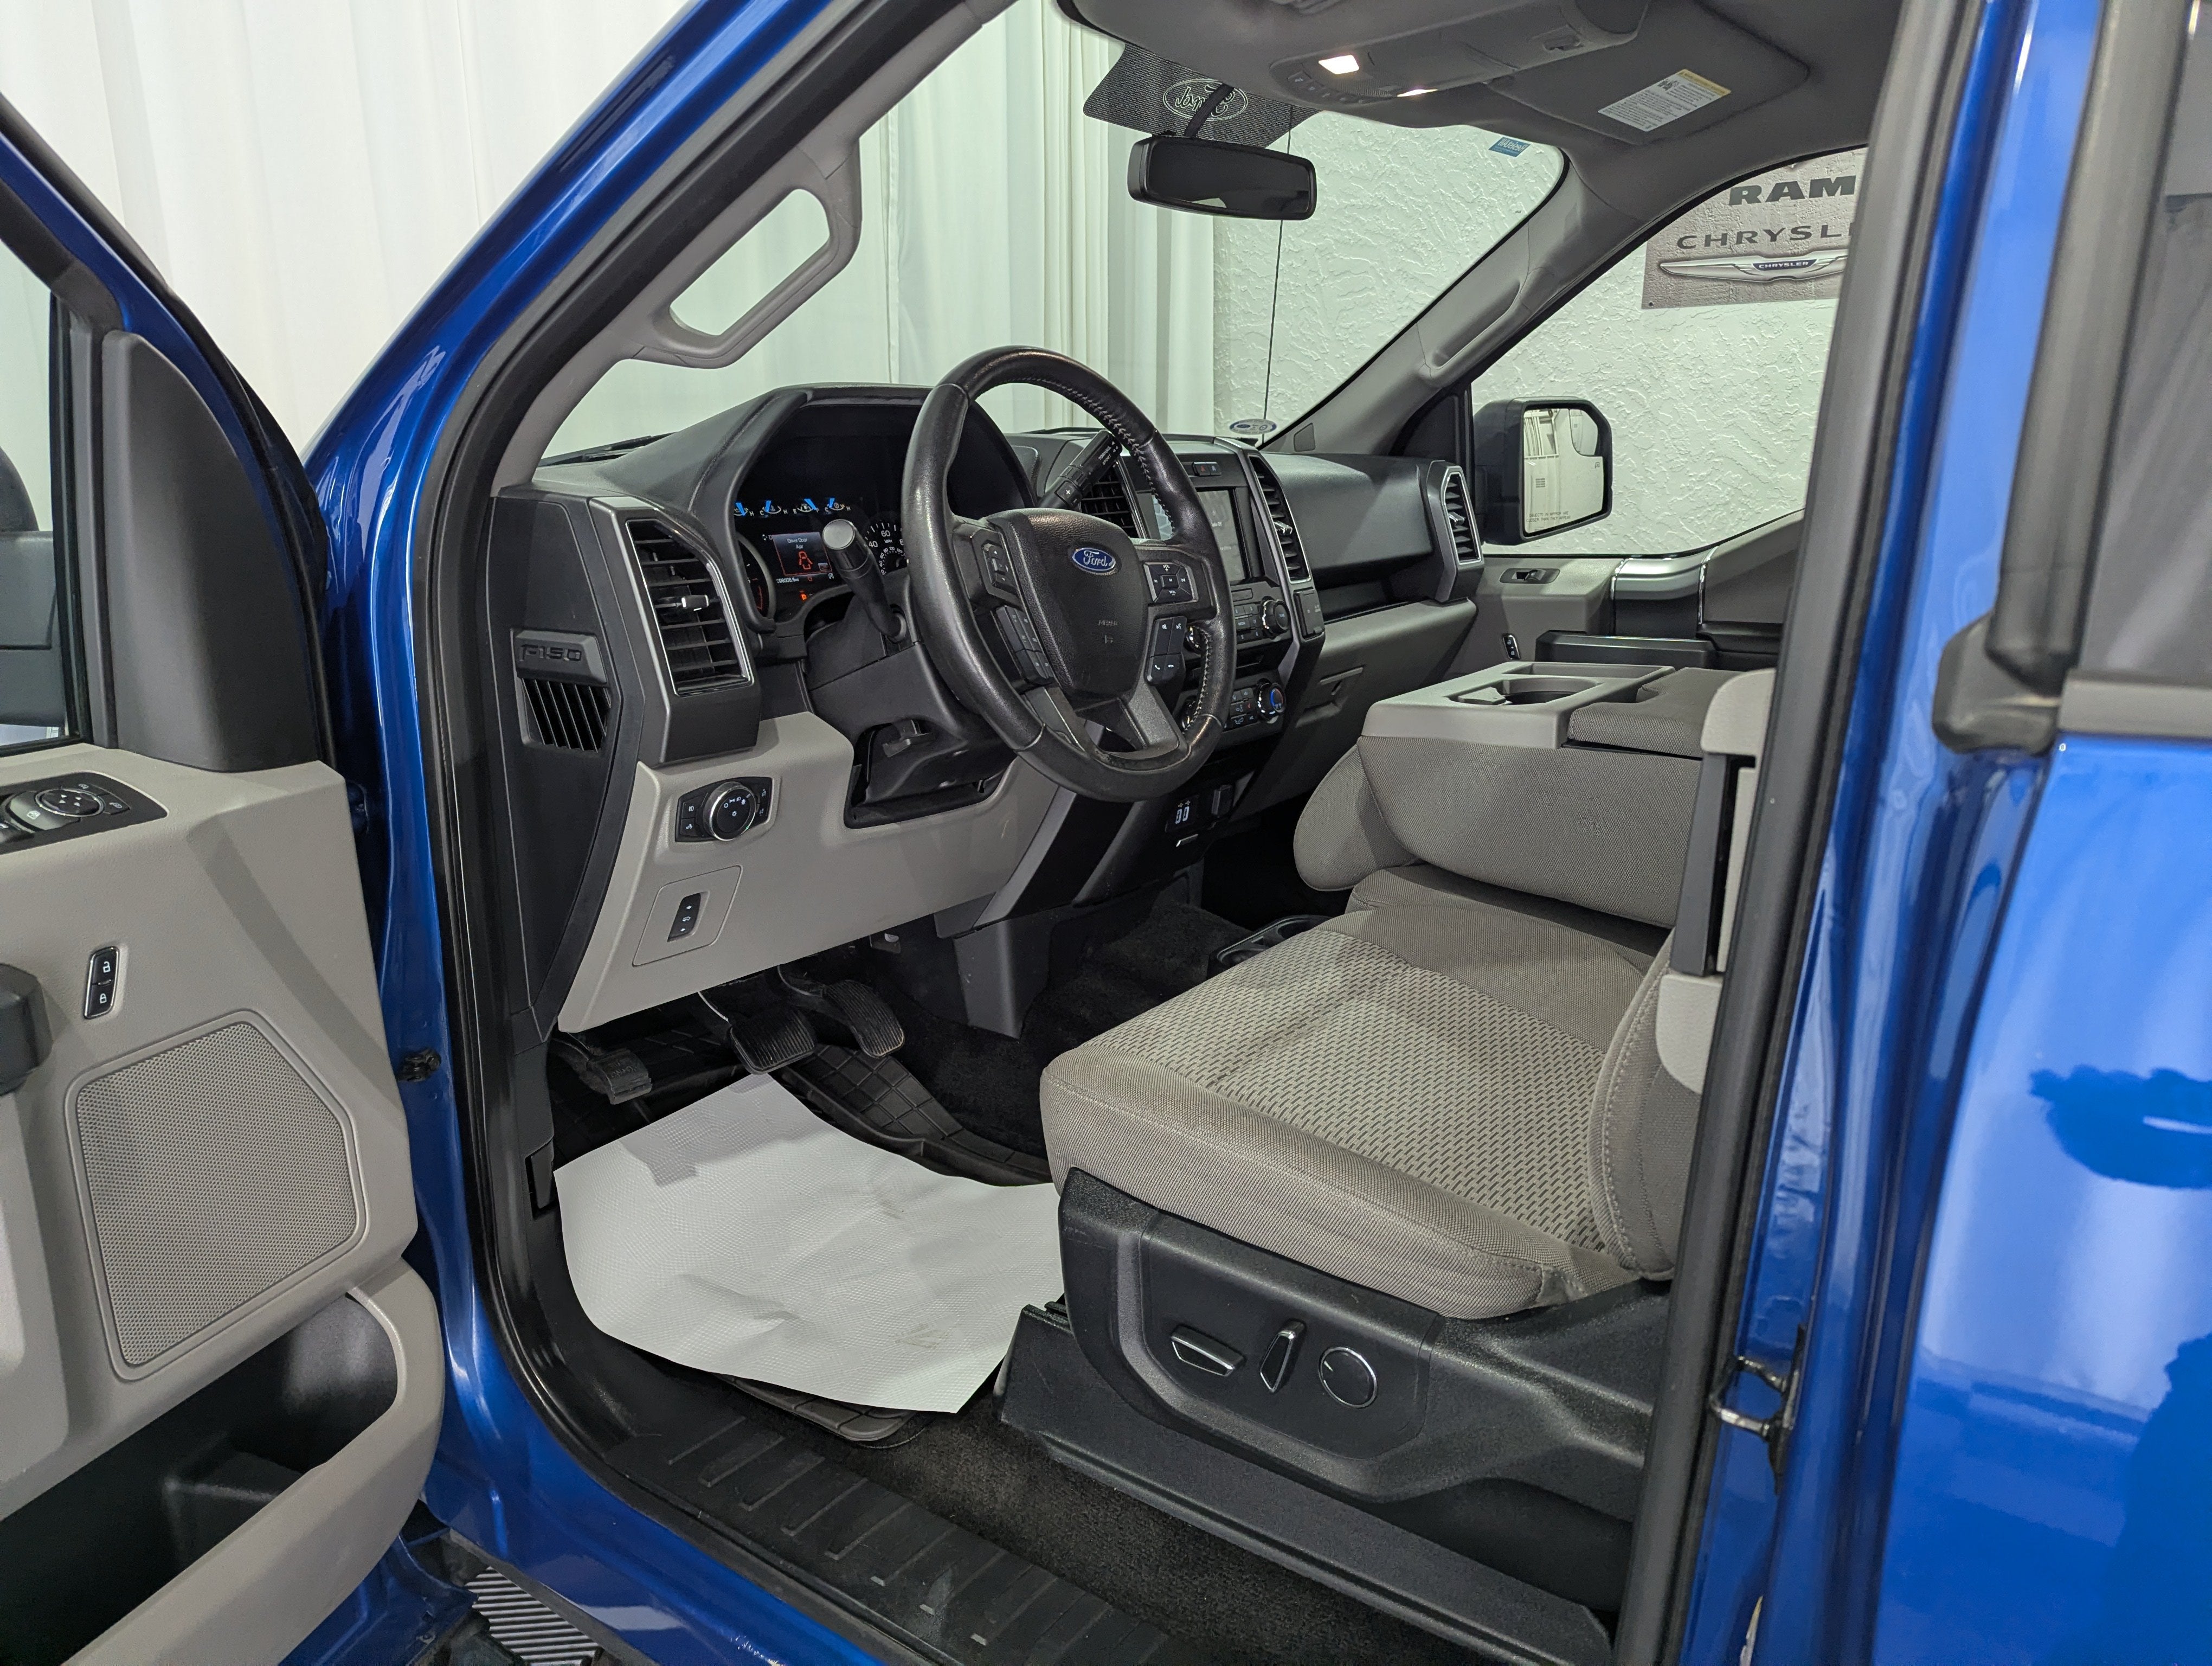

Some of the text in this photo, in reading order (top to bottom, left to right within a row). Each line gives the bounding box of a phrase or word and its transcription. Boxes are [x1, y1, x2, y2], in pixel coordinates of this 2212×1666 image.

[1729, 175, 1856, 206] RAM
[1677, 222, 1854, 249] CHRYSL
[1083, 550, 1108, 567] Ford
